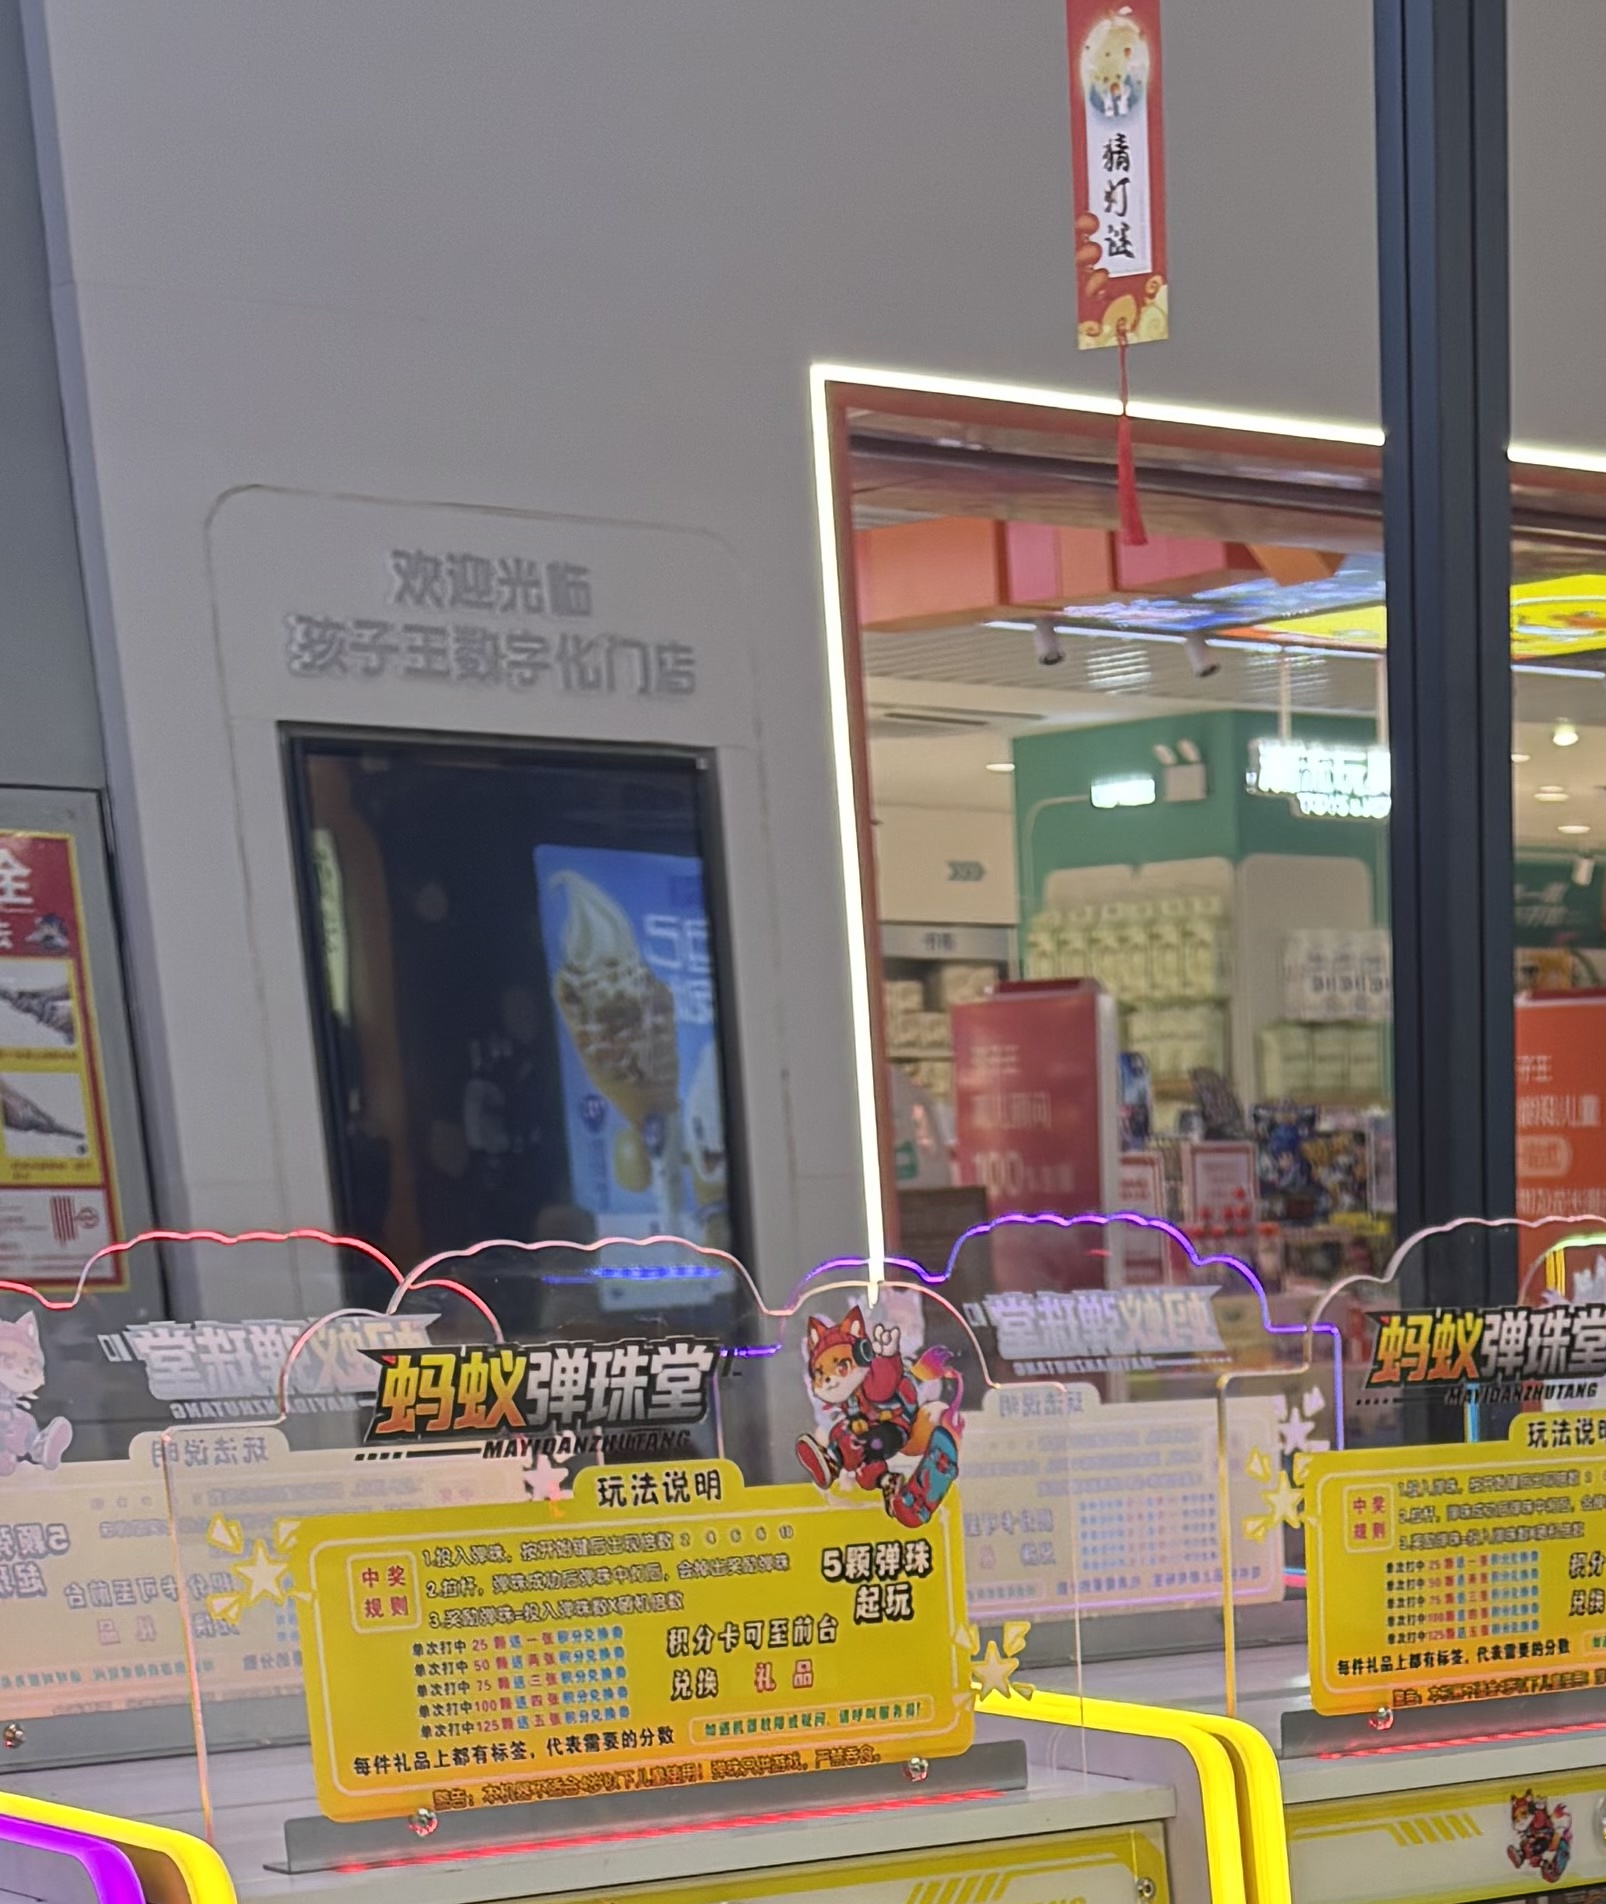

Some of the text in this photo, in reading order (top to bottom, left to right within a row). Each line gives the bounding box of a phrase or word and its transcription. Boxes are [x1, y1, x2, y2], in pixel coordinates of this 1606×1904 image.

[1102, 133, 1136, 259] 猜灯谜
[391, 549, 592, 618] 欢迎光临
[286, 613, 697, 697] 孩子王数字化门店
[374, 1343, 715, 1435] 蚂蚁弹珠堂
[597, 1468, 722, 1508] 玩法说明
[361, 1564, 407, 1589] 中奖
[822, 1538, 933, 1583] 5颗弹珠
[363, 1595, 409, 1619] 规则
[854, 1581, 915, 1625] 起玩
[666, 1612, 839, 1659] 积分卡可至前台
[670, 1666, 720, 1702] 兑换
[754, 1658, 814, 1694] 礼品
[353, 1724, 675, 1777] 每件礼品上都有标签，代表需要的分数
